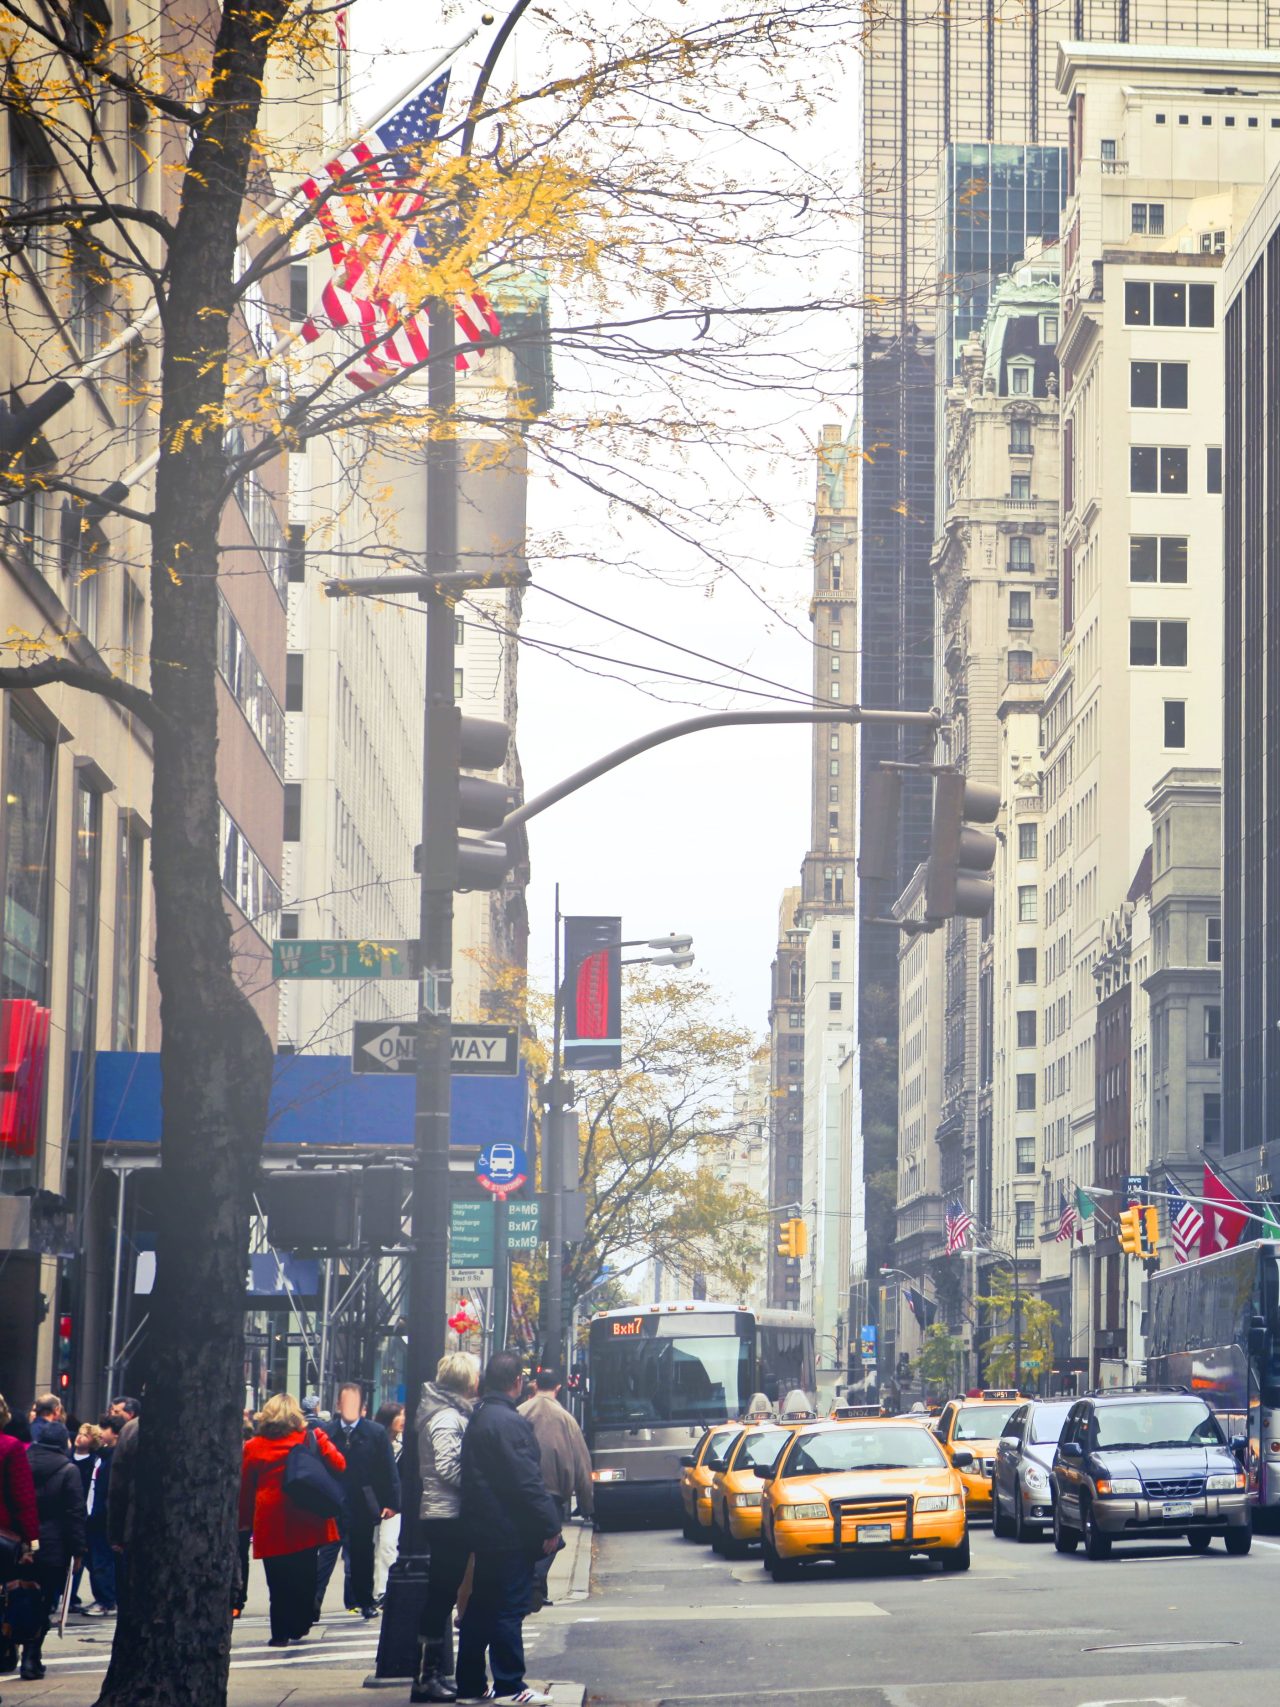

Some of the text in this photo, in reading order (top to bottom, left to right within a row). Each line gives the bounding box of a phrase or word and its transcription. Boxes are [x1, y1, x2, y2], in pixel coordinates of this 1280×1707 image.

[280, 945, 348, 974] W 51
[450, 1039, 497, 1060] WAY
[508, 1219, 539, 1232] BxM7
[507, 1235, 538, 1248] BxM9
[613, 1317, 643, 1335] BxM7
